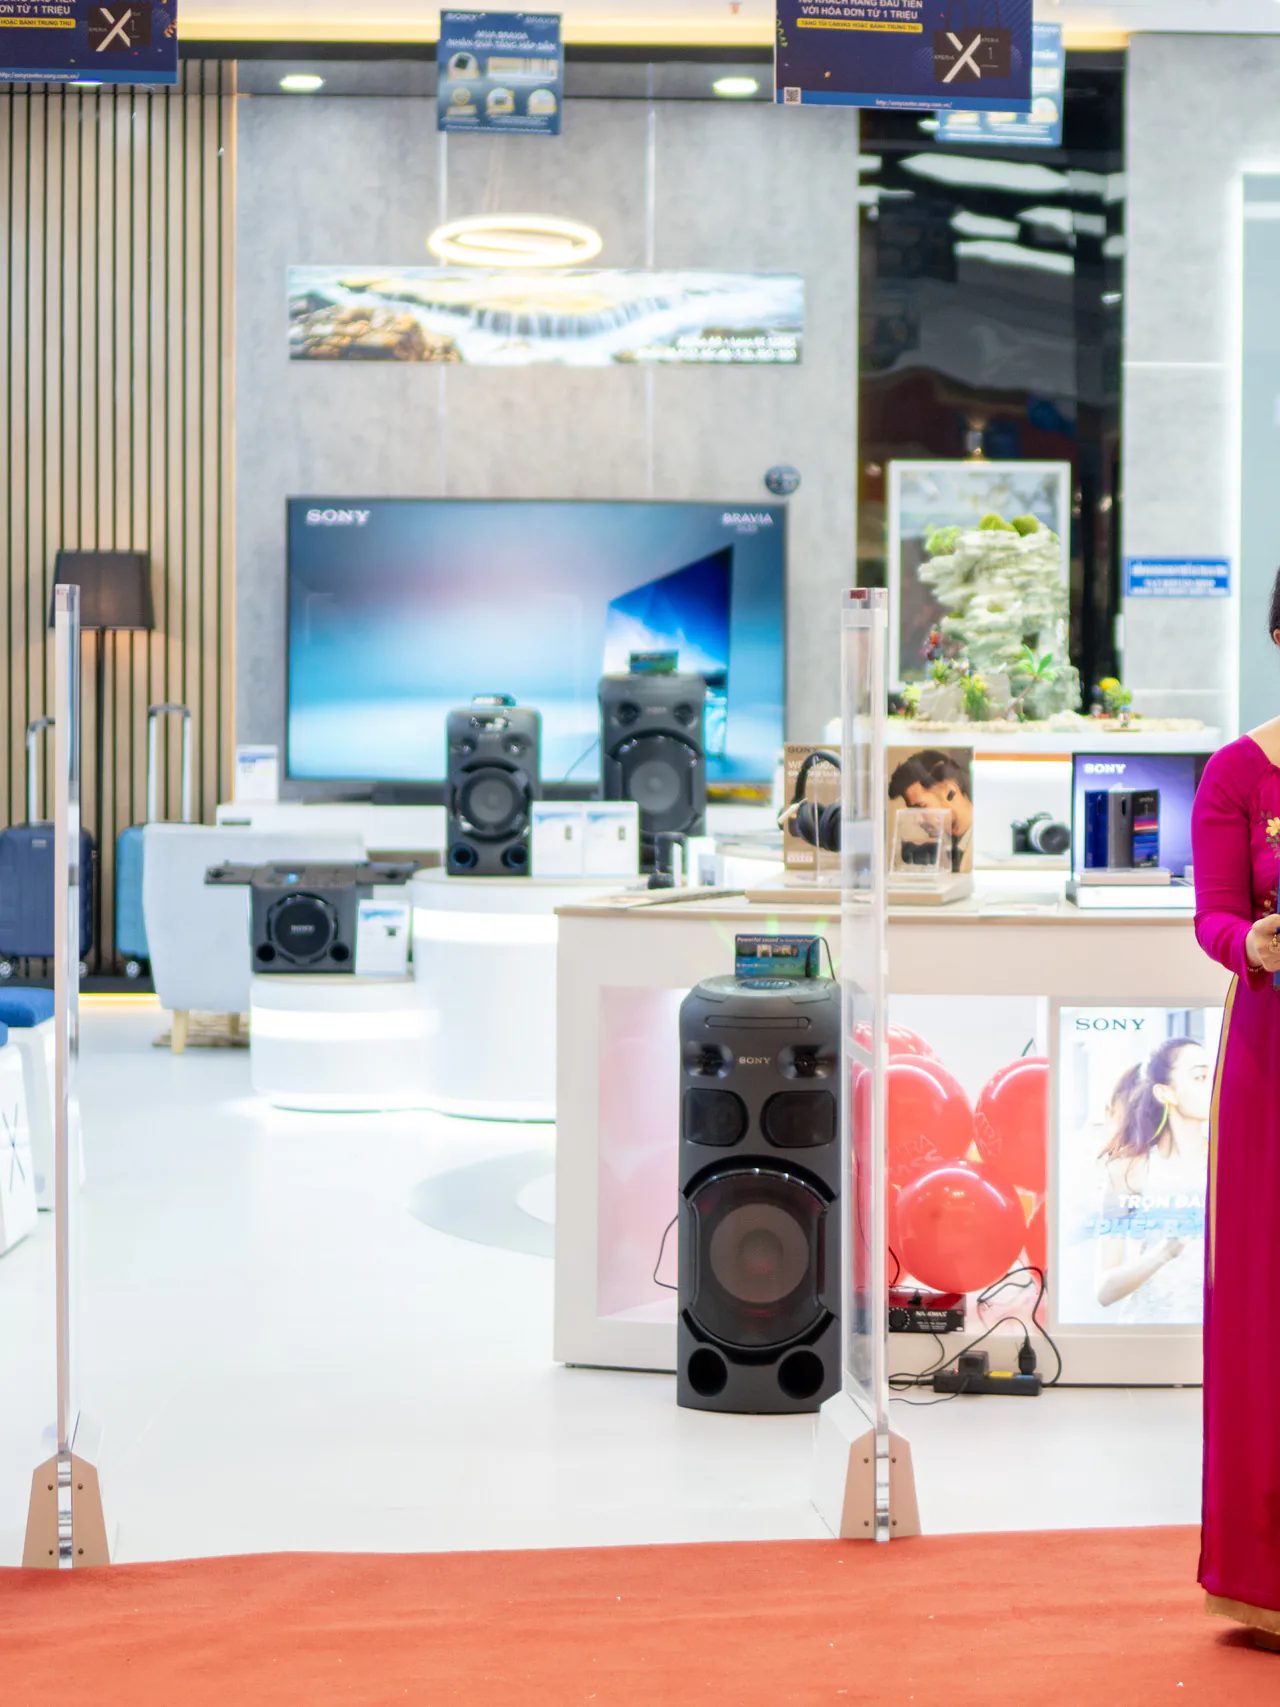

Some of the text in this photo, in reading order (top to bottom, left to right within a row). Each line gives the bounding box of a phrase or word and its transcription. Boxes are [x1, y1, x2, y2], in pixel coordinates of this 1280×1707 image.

[17, 3, 31, 14] TỪ
[42, 5, 71, 16] TRIỆU
[883, 10, 887, 18] 1
[306, 508, 371, 525] SONY
[722, 512, 774, 525] BRAVIA
[787, 746, 817, 754] SONY
[1083, 762, 1127, 775] SONY
[291, 924, 315, 934] SONY
[1075, 1017, 1146, 1031] SONY
[738, 1056, 772, 1065] SONY
[1119, 1194, 1170, 1211] TRỌN
